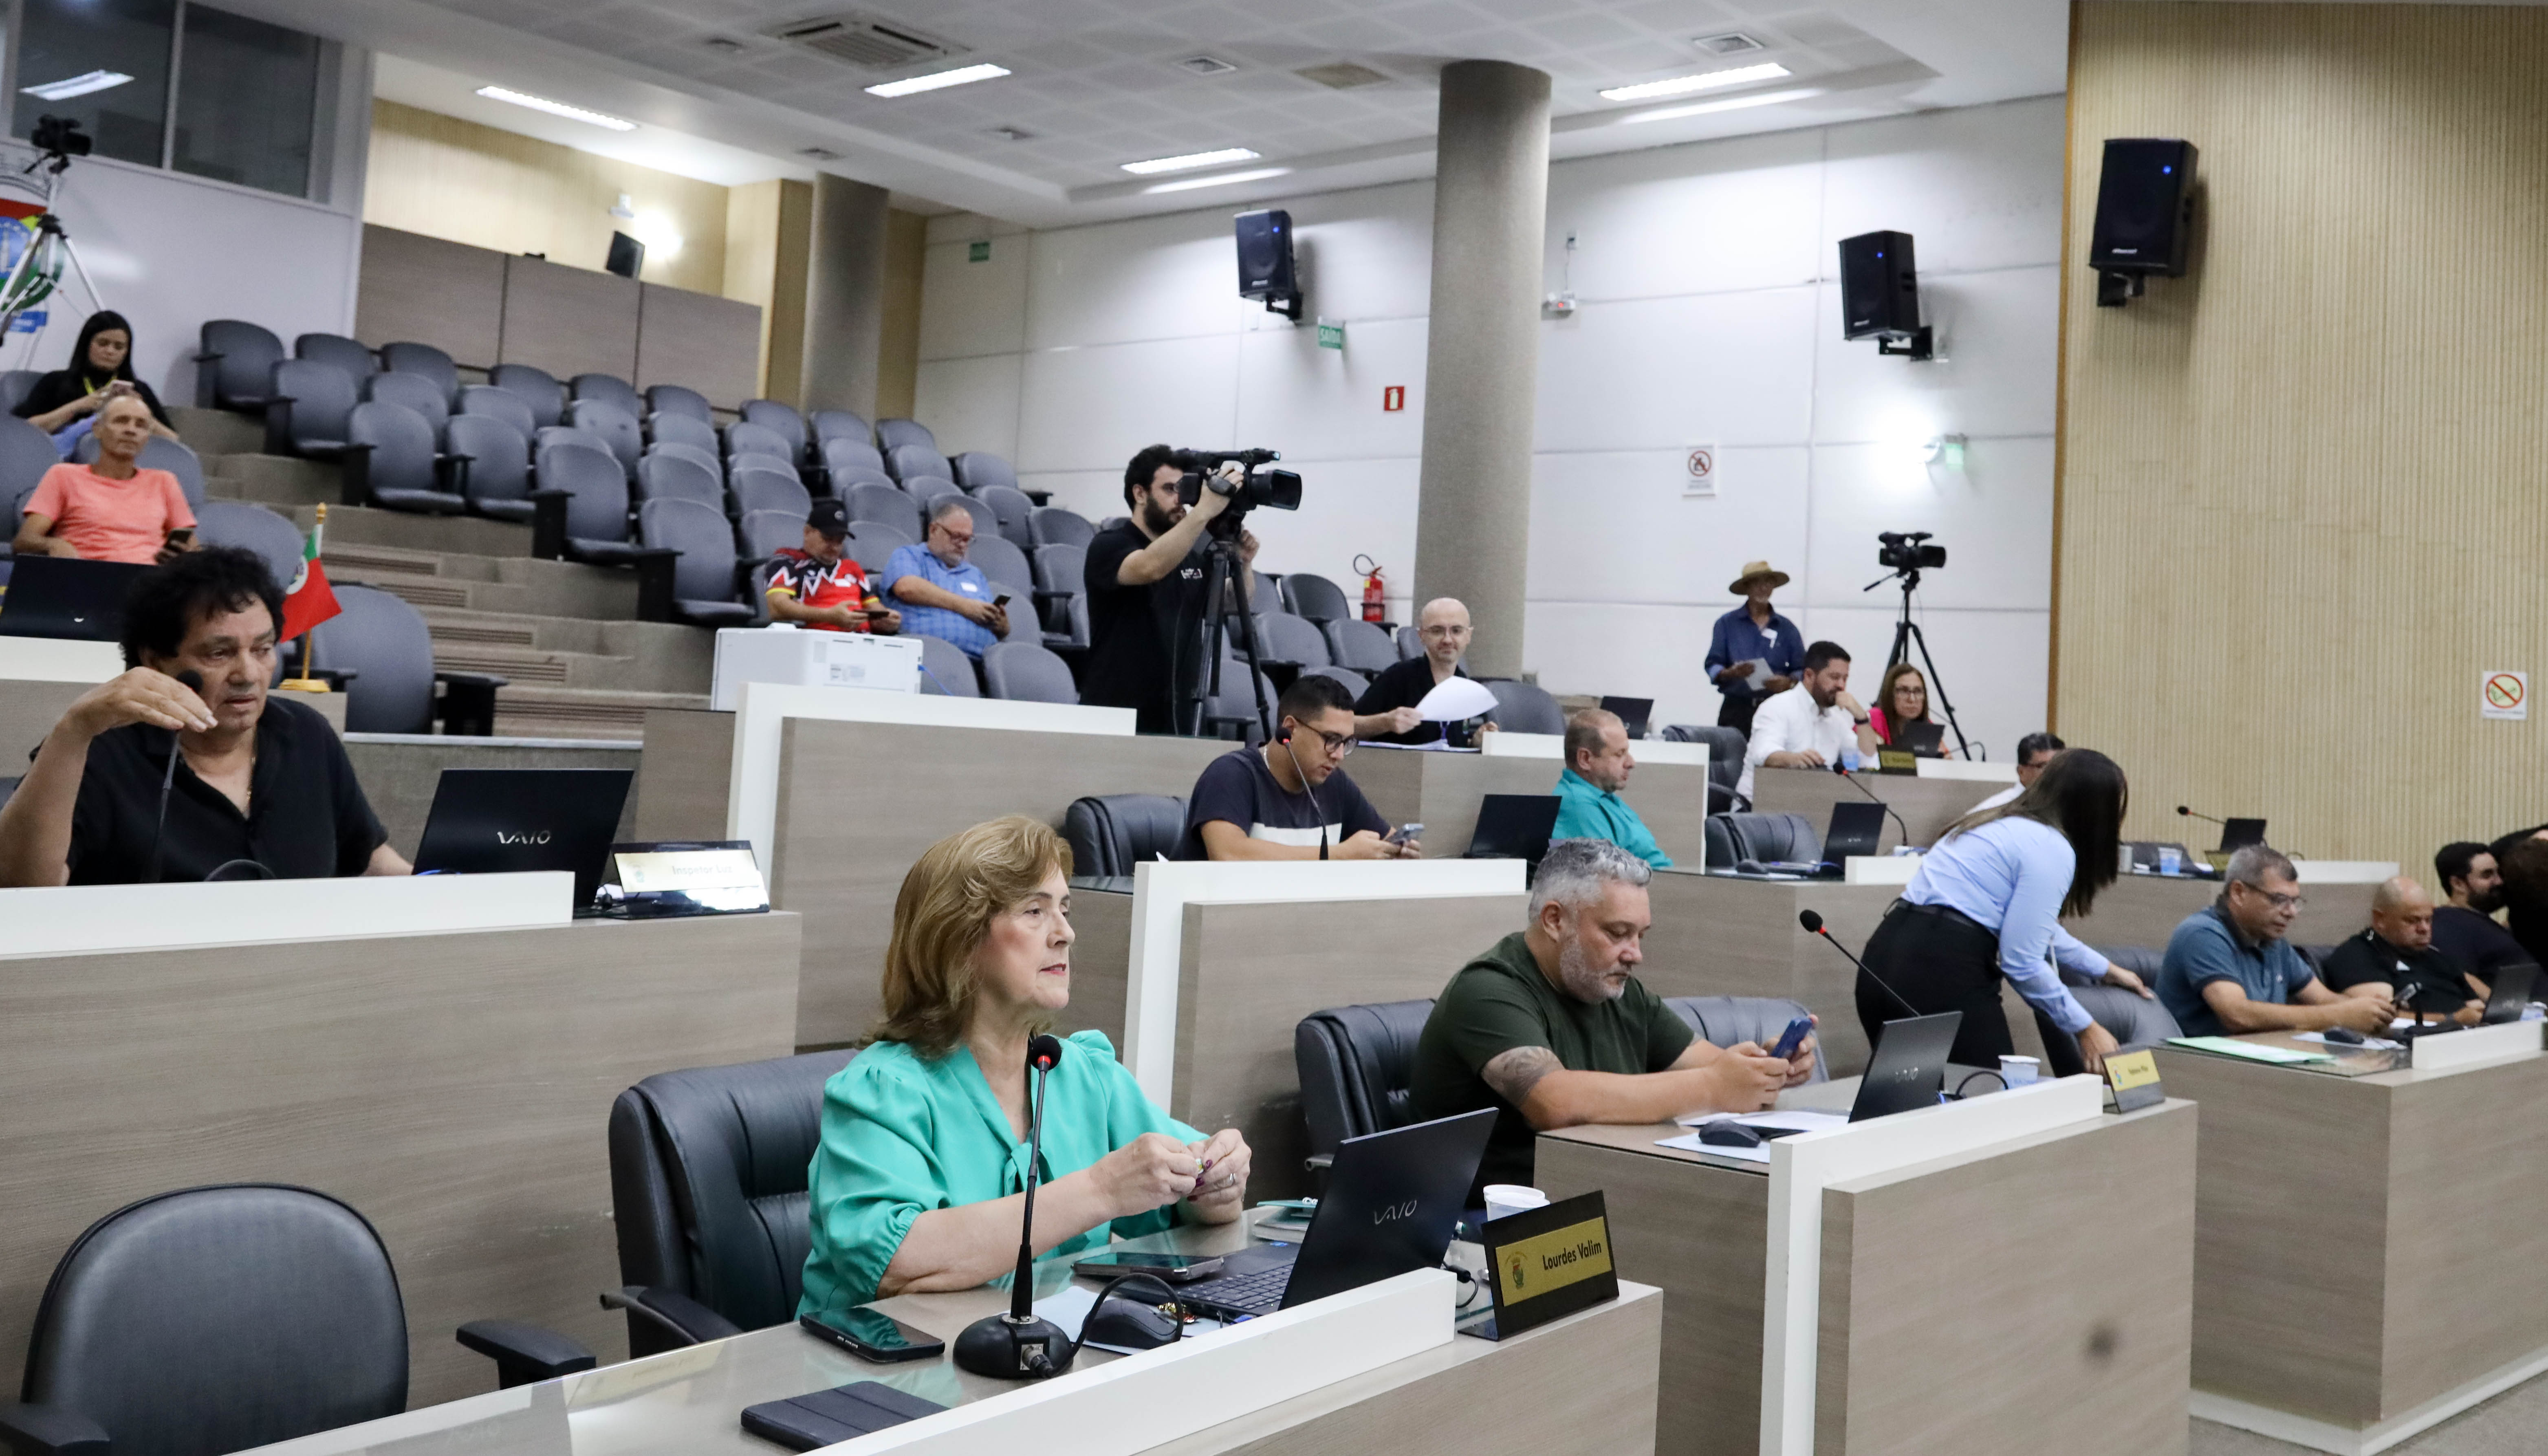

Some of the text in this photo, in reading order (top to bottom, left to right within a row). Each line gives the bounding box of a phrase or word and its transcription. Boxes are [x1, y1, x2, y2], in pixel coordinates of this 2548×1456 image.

[497, 830, 551, 844] VAIO
[672, 864, 733, 877] Inspetor Luz
[1374, 1200, 1417, 1225] VAIO
[1542, 1247, 1577, 1270] Lourdes
[1577, 1240, 1602, 1259] Valim
